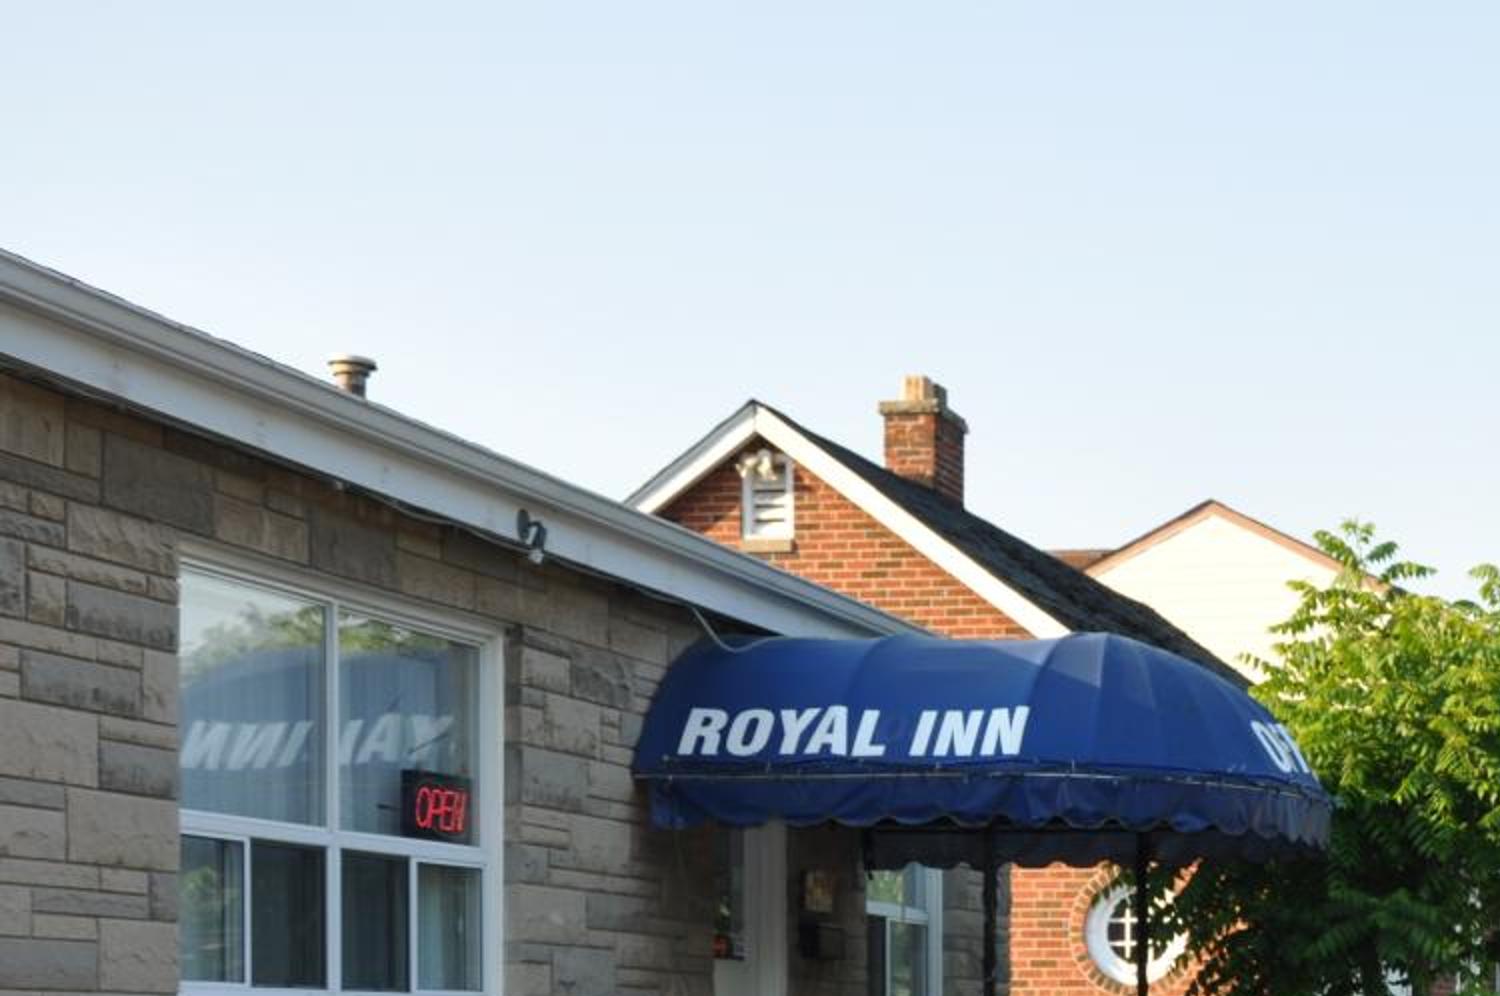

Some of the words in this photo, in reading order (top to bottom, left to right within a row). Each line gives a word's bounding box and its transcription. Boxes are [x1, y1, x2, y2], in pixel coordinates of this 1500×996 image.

[677, 704, 887, 758] ROYAL
[908, 704, 1030, 758] INN
[415, 786, 467, 833] OPEN
